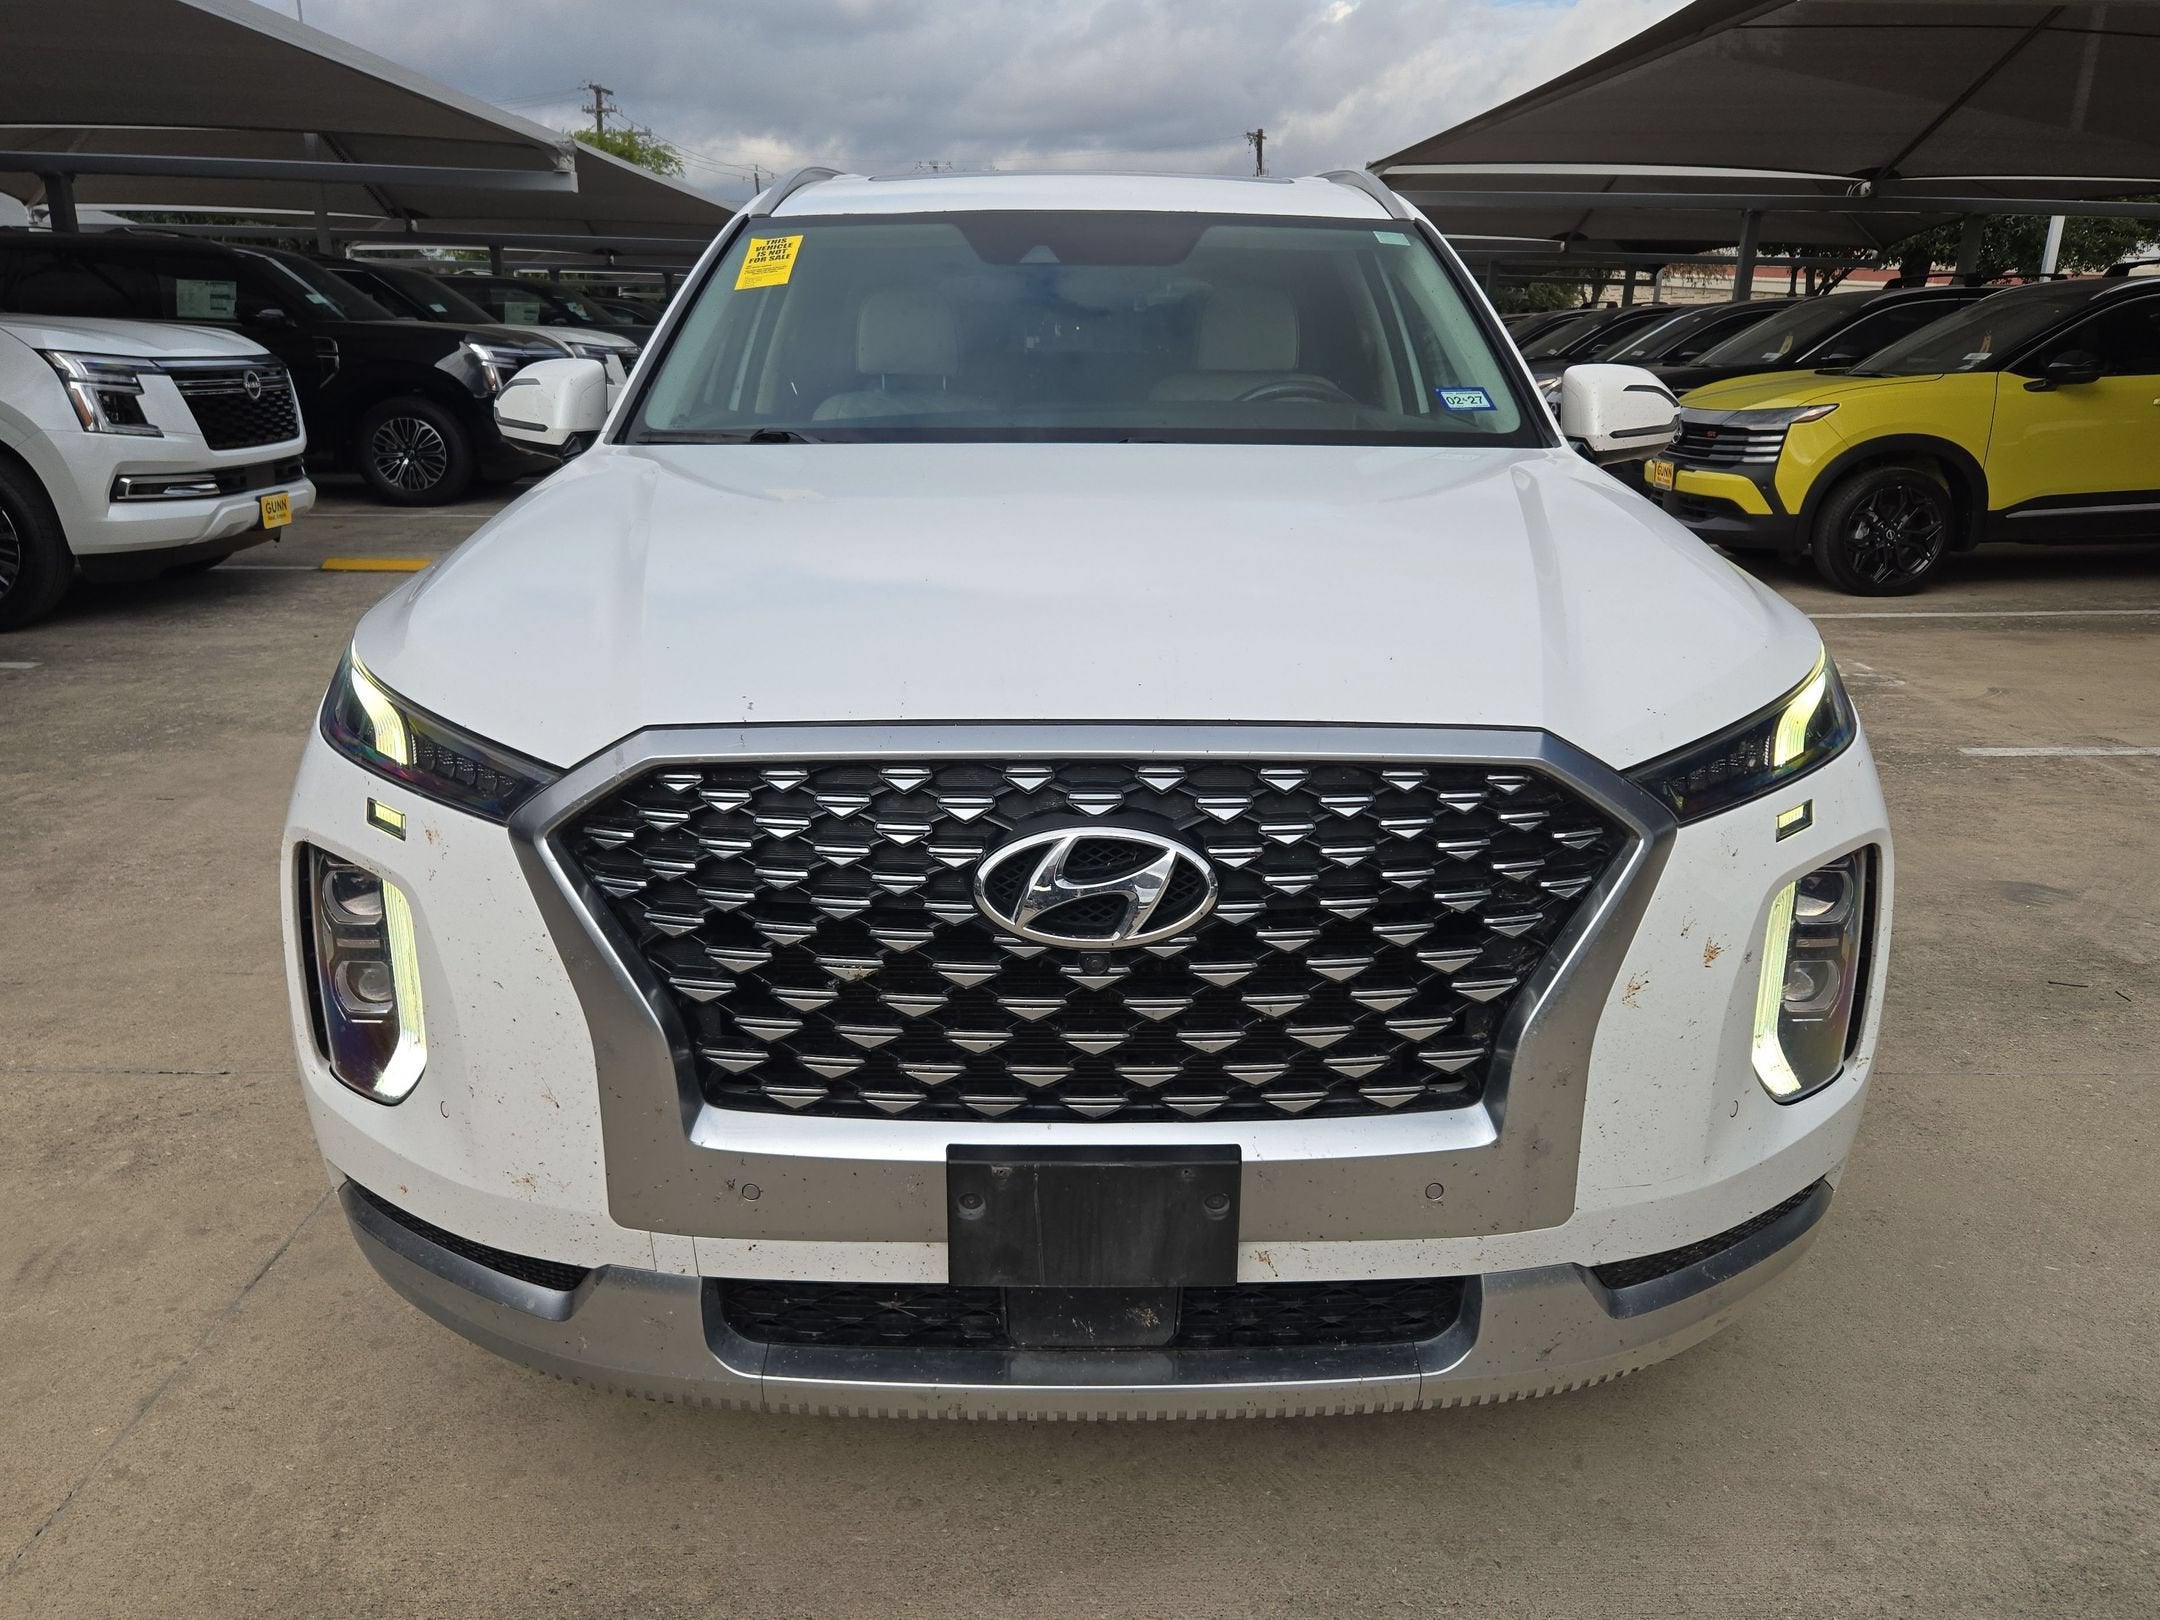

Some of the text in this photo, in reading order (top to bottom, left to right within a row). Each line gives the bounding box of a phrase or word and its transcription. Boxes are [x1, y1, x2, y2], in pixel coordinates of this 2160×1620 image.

[756, 242, 793, 252] VEHICLE
[766, 238, 788, 246] THIS
[748, 253, 792, 264] FOR SALE
[265, 498, 288, 514] GUNN
